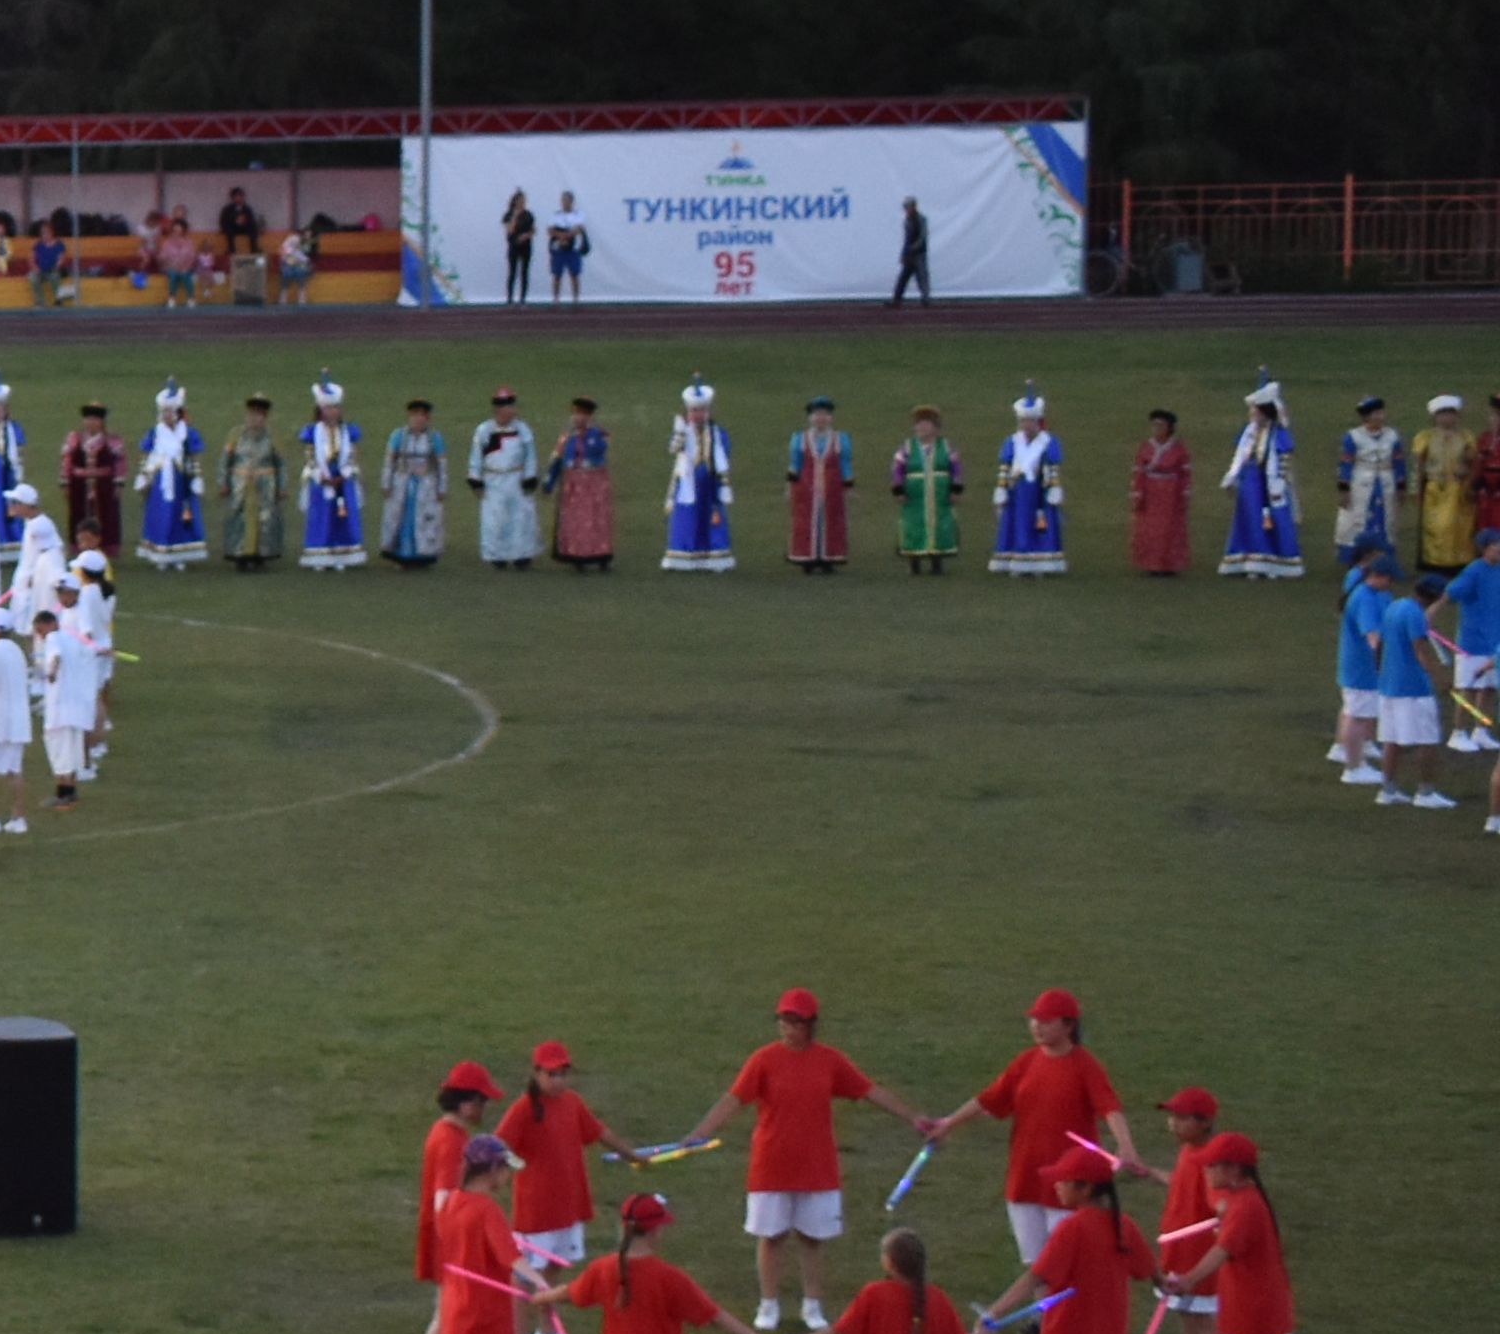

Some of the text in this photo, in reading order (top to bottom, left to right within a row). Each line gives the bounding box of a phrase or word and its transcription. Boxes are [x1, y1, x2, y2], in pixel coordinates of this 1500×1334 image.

[624, 187, 850, 222] ТУНКИНСКИЙ
[698, 226, 774, 250] район
[715, 251, 756, 278] 95
[715, 282, 754, 296] лет
